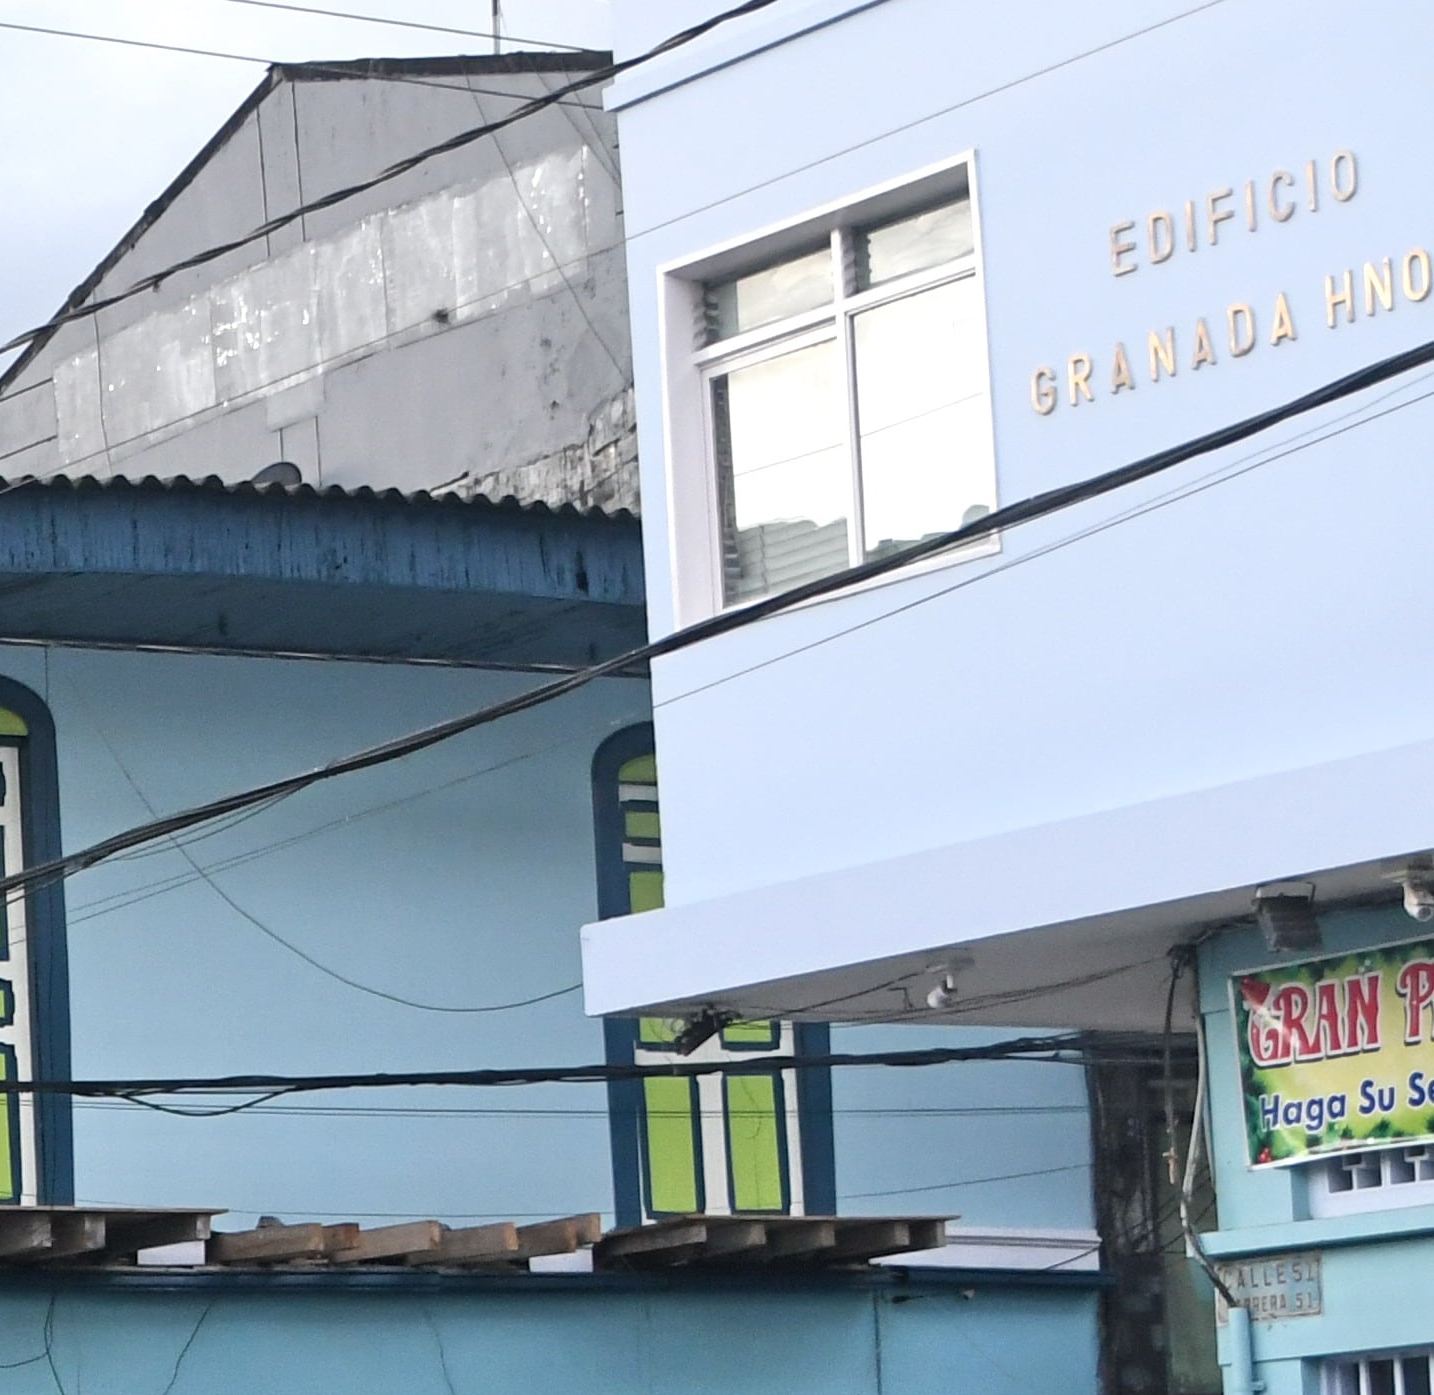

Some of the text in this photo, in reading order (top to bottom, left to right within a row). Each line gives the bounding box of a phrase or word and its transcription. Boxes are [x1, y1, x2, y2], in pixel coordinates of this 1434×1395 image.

[1110, 148, 1359, 278] EDIFICIO
[1029, 247, 1434, 416] GRANADA HNO
[1248, 973, 1381, 1066] GRAN
[1260, 1093, 1346, 1132] Haga
[1359, 1080, 1395, 1115] Su
[1293, 1261, 1315, 1282] 51
[1296, 1291, 1314, 1309] 51
